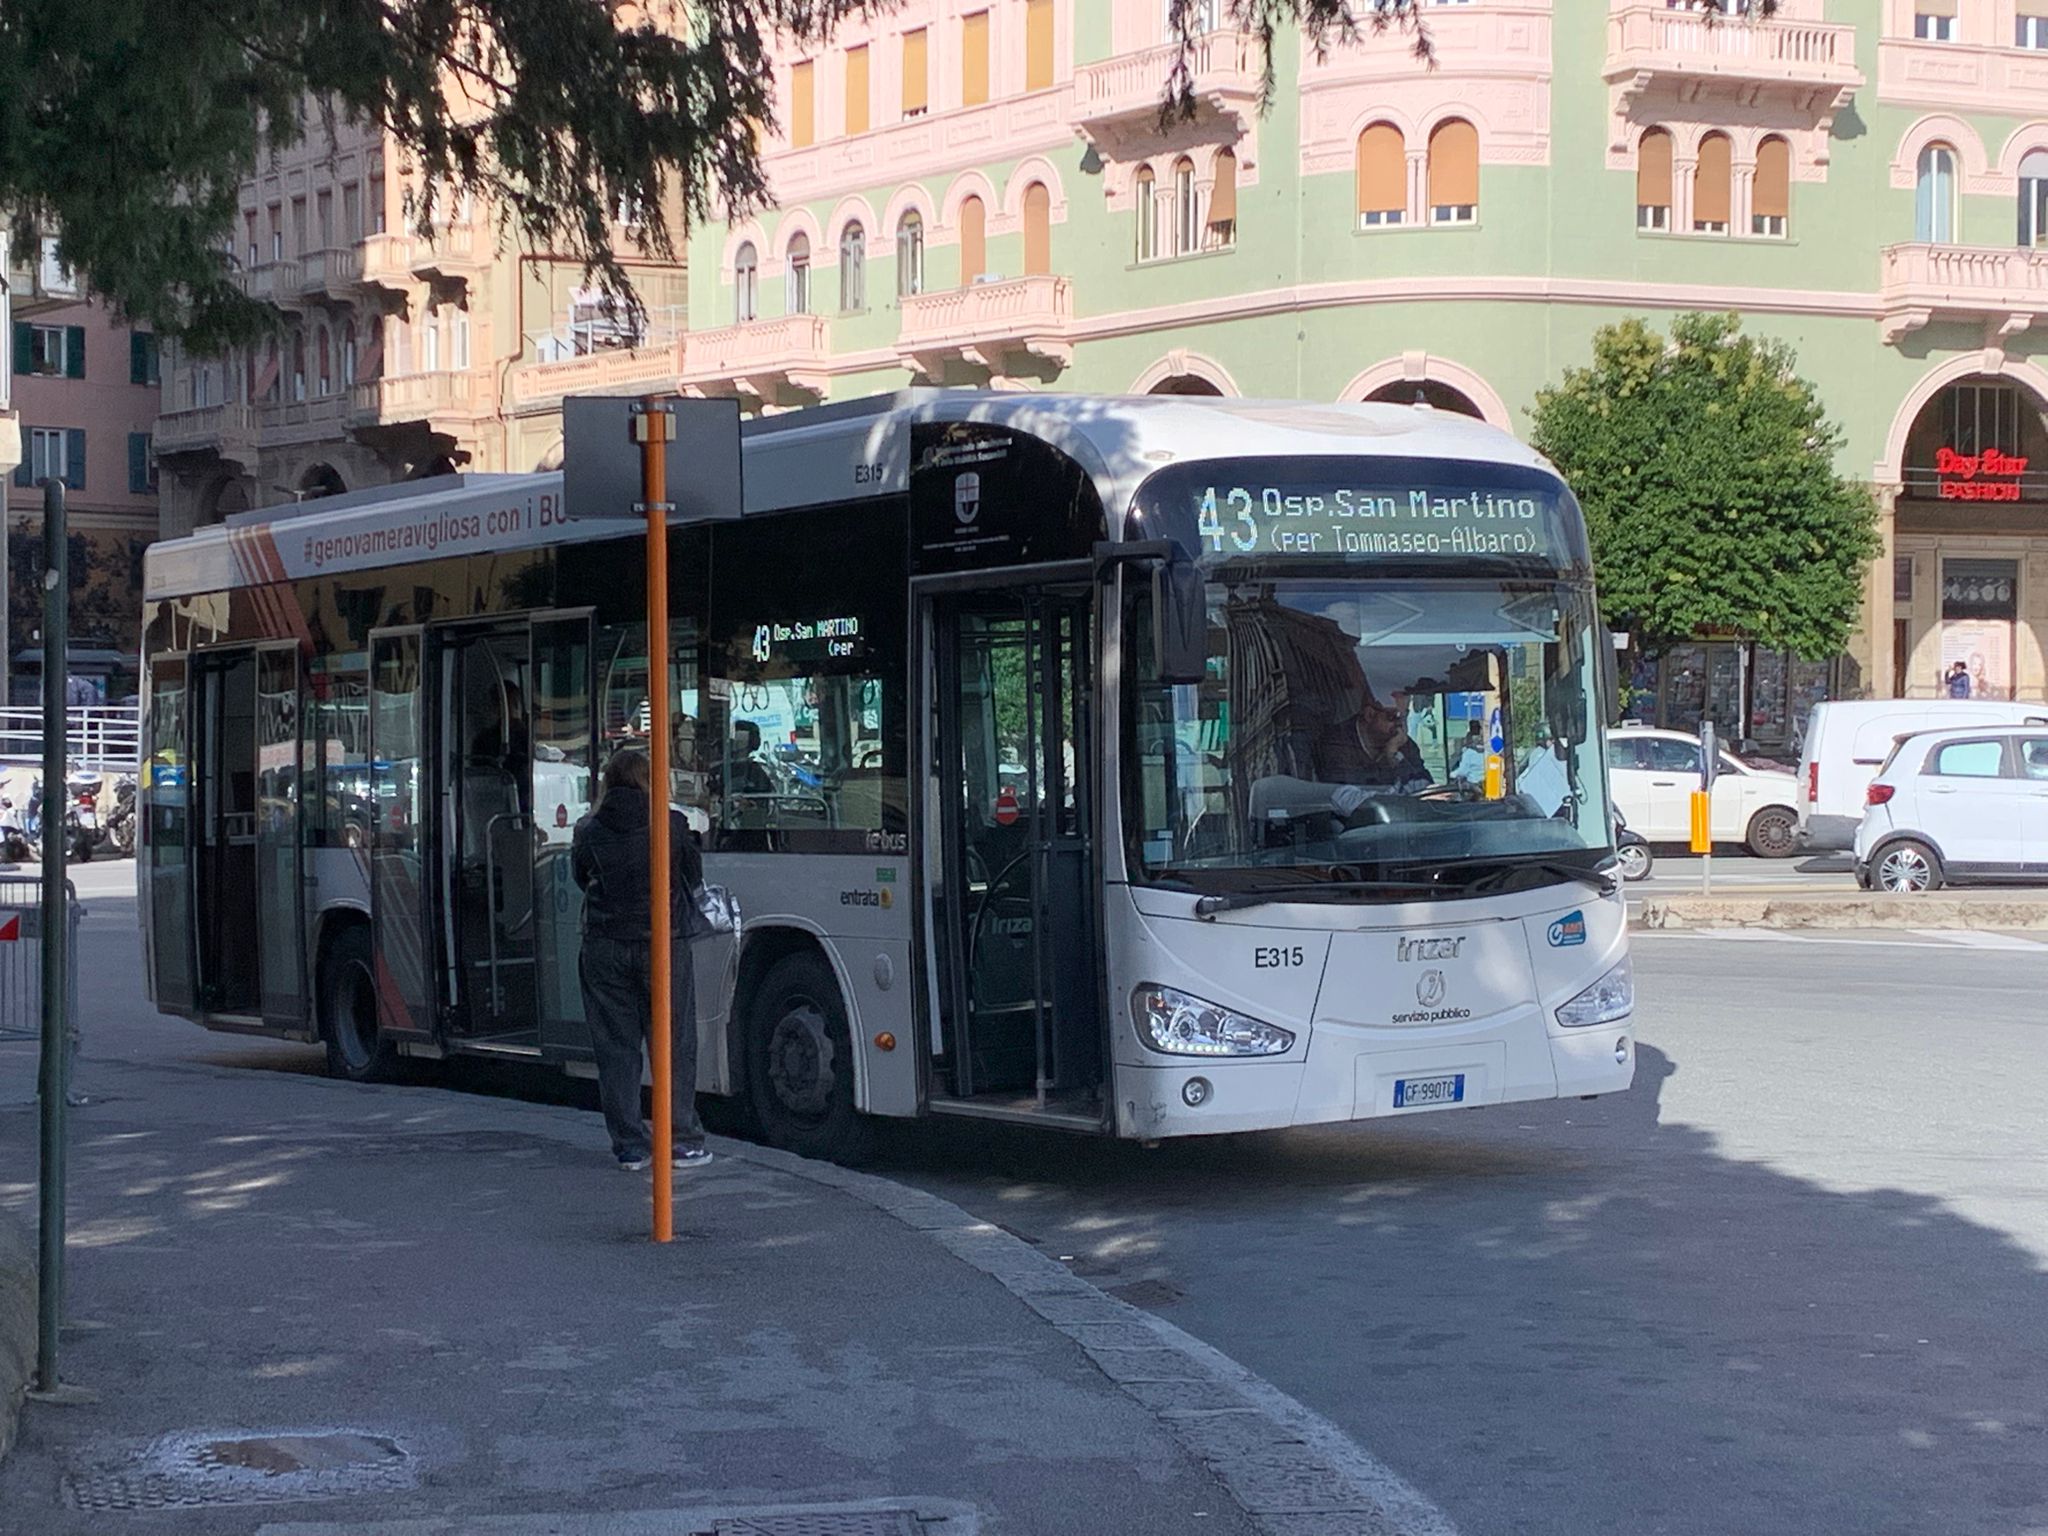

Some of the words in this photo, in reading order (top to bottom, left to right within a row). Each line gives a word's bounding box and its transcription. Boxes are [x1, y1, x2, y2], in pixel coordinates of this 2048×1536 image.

[855, 463, 884, 484] E315
[1936, 448, 1979, 479] Day
[1942, 481, 2021, 500] FASHION
[304, 511, 480, 567] #genovameravigliosa
[487, 507, 520, 535] con
[527, 498, 532, 529] i
[540, 493, 581, 527] BU
[1198, 487, 1258, 552] 43
[1262, 488, 1397, 518] Osp.San
[1409, 490, 1536, 519] Martino
[1271, 524, 1323, 553] (per
[1331, 525, 1537, 553] Tommaseo-Albaro)
[752, 624, 770, 663] 43
[816, 616, 858, 638] MARTINO
[827, 638, 855, 657] (per
[840, 888, 880, 907] entrata
[991, 915, 1033, 935] Iriza
[1255, 946, 1304, 968] E315
[1392, 1010, 1430, 1024] servizio
[1430, 1007, 1471, 1022] pubblico
